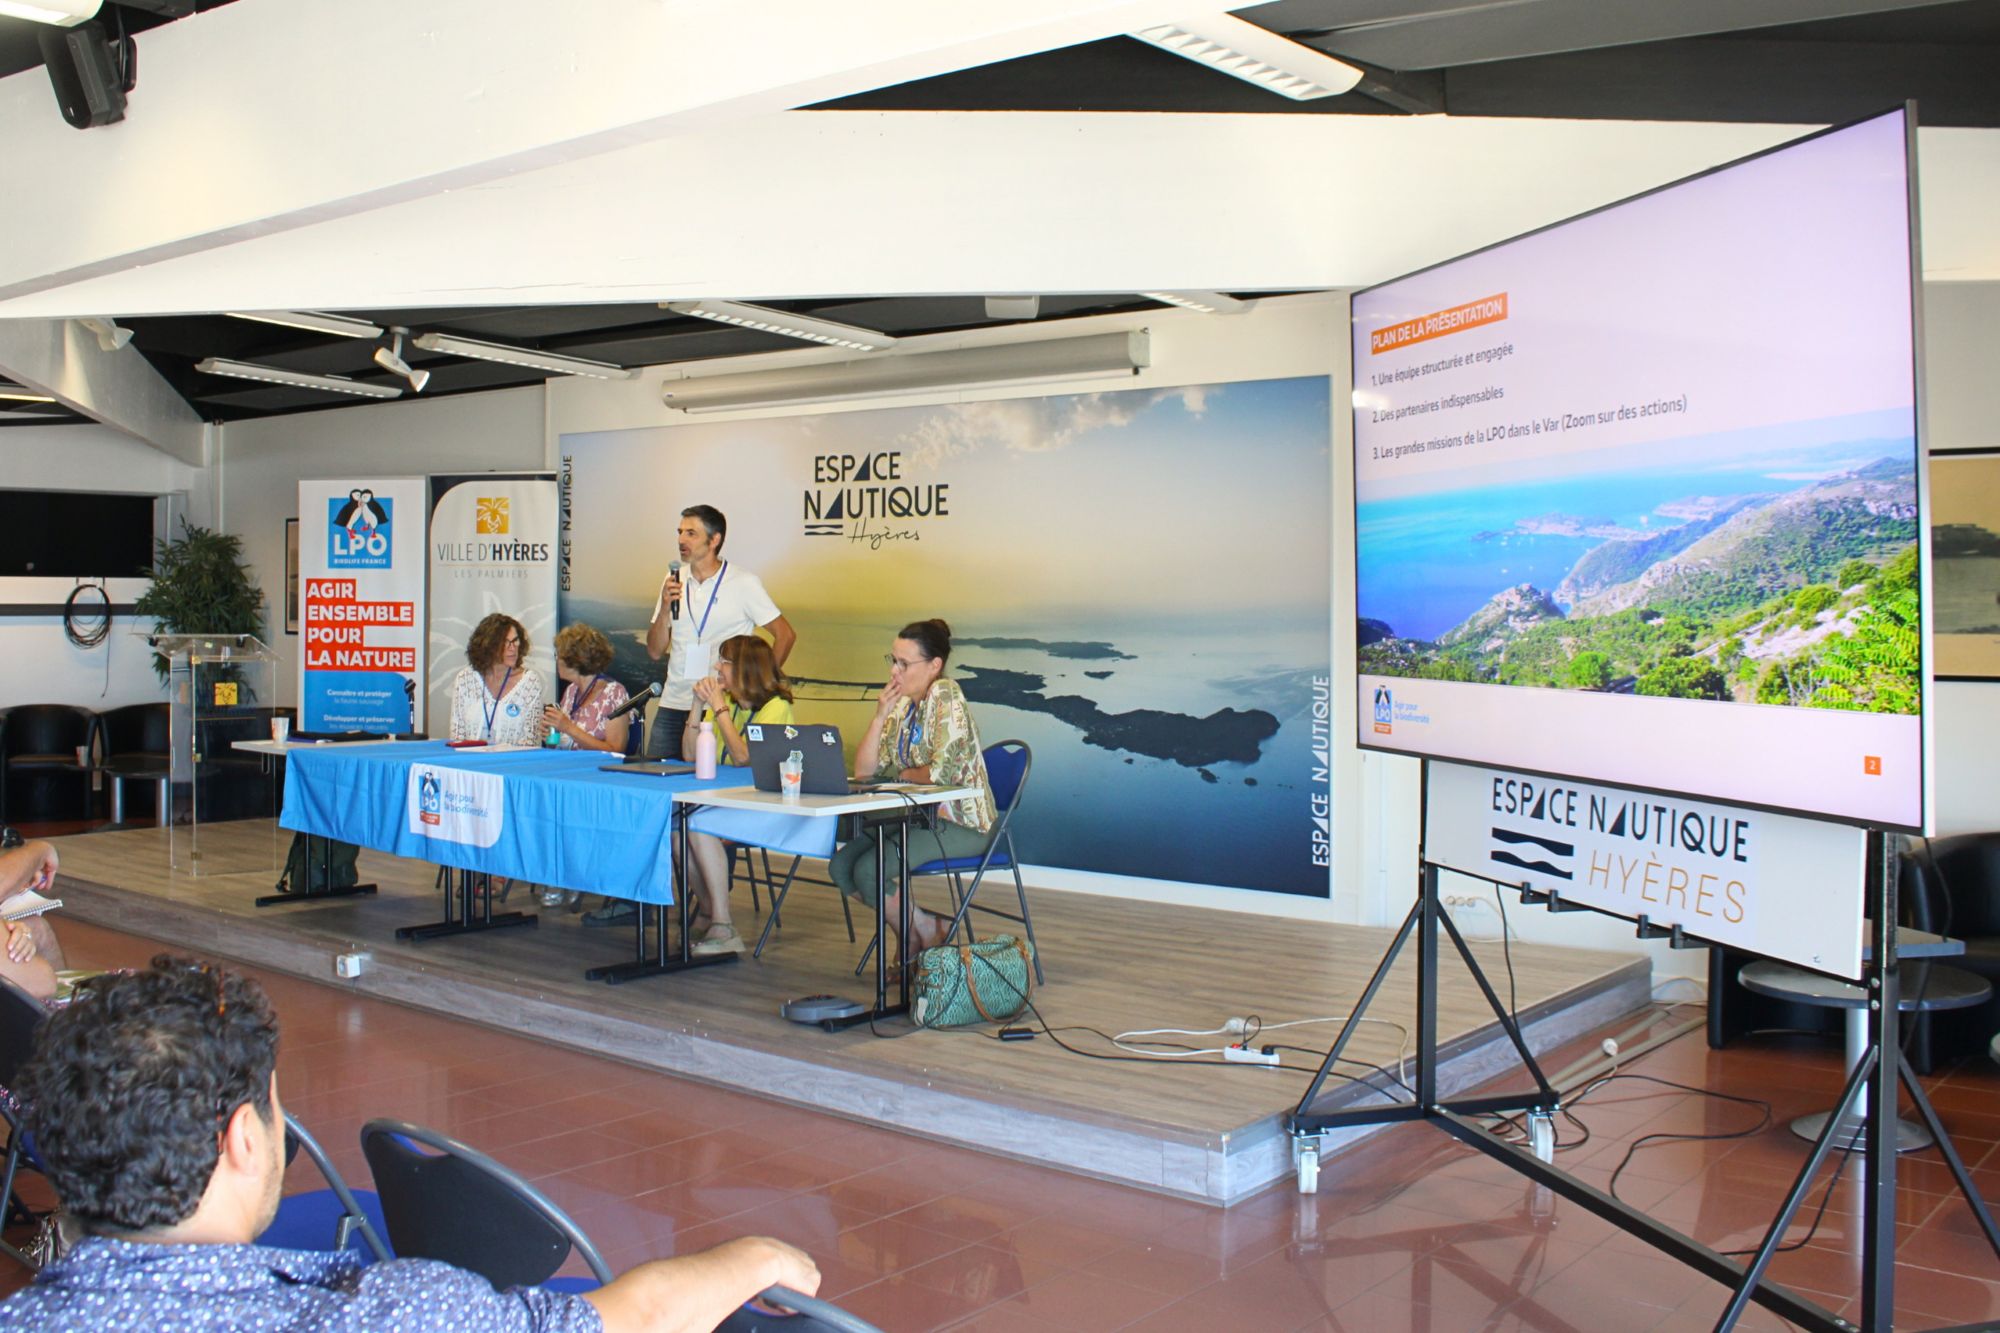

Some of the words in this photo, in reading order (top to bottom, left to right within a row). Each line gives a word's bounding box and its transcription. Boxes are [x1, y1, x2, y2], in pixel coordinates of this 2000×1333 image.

[1372, 330, 1396, 349] PLAN
[1398, 325, 1411, 342] DE
[1412, 321, 1424, 338] LA
[1425, 299, 1503, 335] PRÉSENTATION
[1372, 375, 1378, 386] 1.
[1378, 373, 1393, 385] Une
[1395, 365, 1420, 383] équipe
[1421, 354, 1463, 376] structurée
[1465, 353, 1474, 365] et
[1476, 342, 1513, 363] engagée
[1372, 411, 1378, 423] 2.
[1380, 409, 1394, 422] Des
[1396, 400, 1439, 421] partenaires
[1441, 386, 1504, 409] indispensables
[1373, 447, 1379, 459] 3.
[1381, 446, 1393, 458] Les
[1395, 441, 1425, 459] grandes
[1427, 435, 1462, 451] missions
[1464, 431, 1475, 445] de
[1477, 429, 1484, 443] la
[1486, 425, 1505, 442] LPO
[1508, 423, 1530, 438] dans
[1532, 420, 1540, 434] le
[1542, 418, 1559, 432] Var
[1562, 413, 1595, 433] (Zoom
[1598, 411, 1615, 424] sur
[1618, 404, 1637, 420] des
[1640, 394, 1687, 417] actions)
[815, 452, 901, 483] ESPACE
[804, 484, 949, 520] NAUTIQUE
[334, 533, 387, 556] LPO
[437, 543, 473, 561] VILLE
[479, 538, 549, 561] D'HYÈRES
[847, 517, 920, 550] Hyères
[307, 582, 354, 598] AGIR
[455, 569, 473, 578] LES
[478, 569, 529, 578] PALMIERS
[308, 604, 412, 621] ENSEMBLE
[307, 627, 361, 644] POUR
[307, 650, 332, 666] LA
[336, 650, 414, 667] NATURE
[1312, 675, 1329, 782] NAUTIQUE
[1869, 760, 1876, 770] 2
[1312, 793, 1329, 866] ESPACE
[1493, 777, 1577, 827] ESPACE
[1589, 794, 1749, 862] NAUTIQUE
[1589, 850, 1746, 923] HYÈRES
